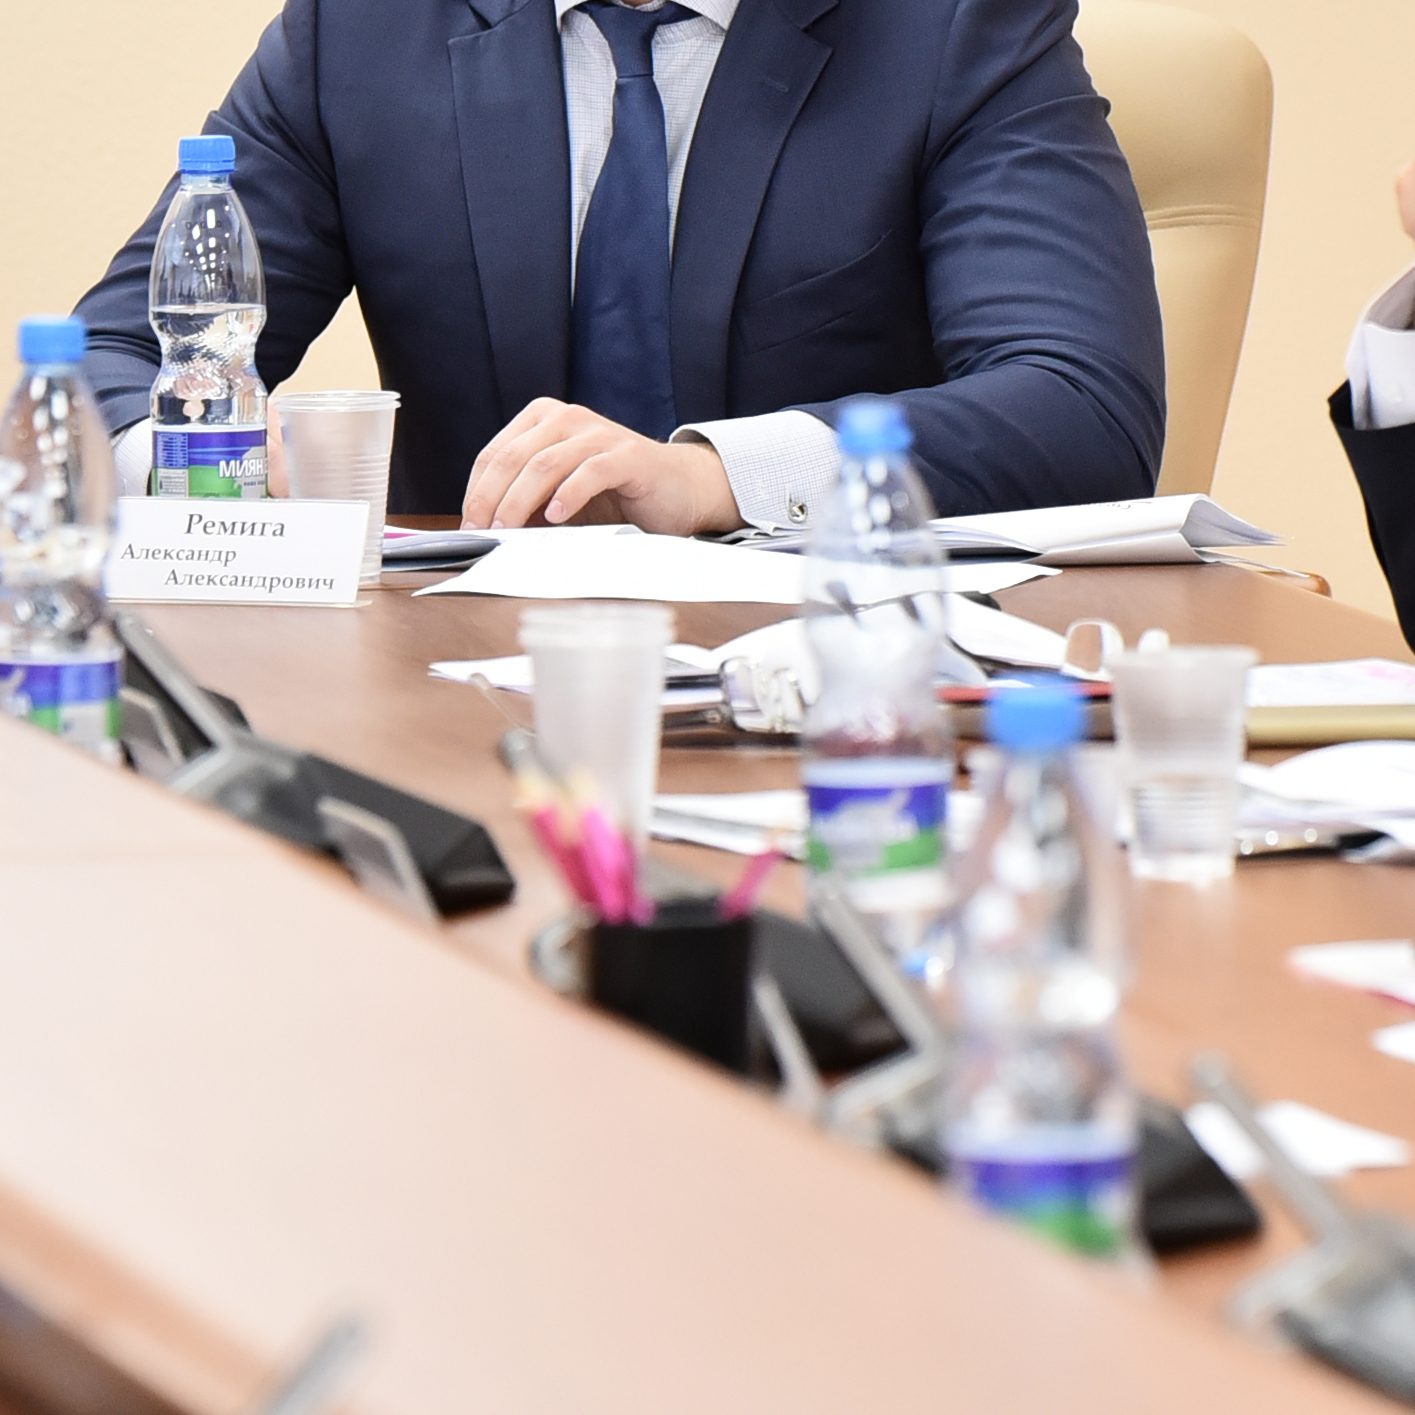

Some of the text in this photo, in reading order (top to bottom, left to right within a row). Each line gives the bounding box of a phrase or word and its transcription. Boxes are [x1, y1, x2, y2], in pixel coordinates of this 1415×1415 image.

[183, 512, 286, 538] Ремига
[120, 543, 237, 568] Александр
[164, 568, 335, 594] Александрович
